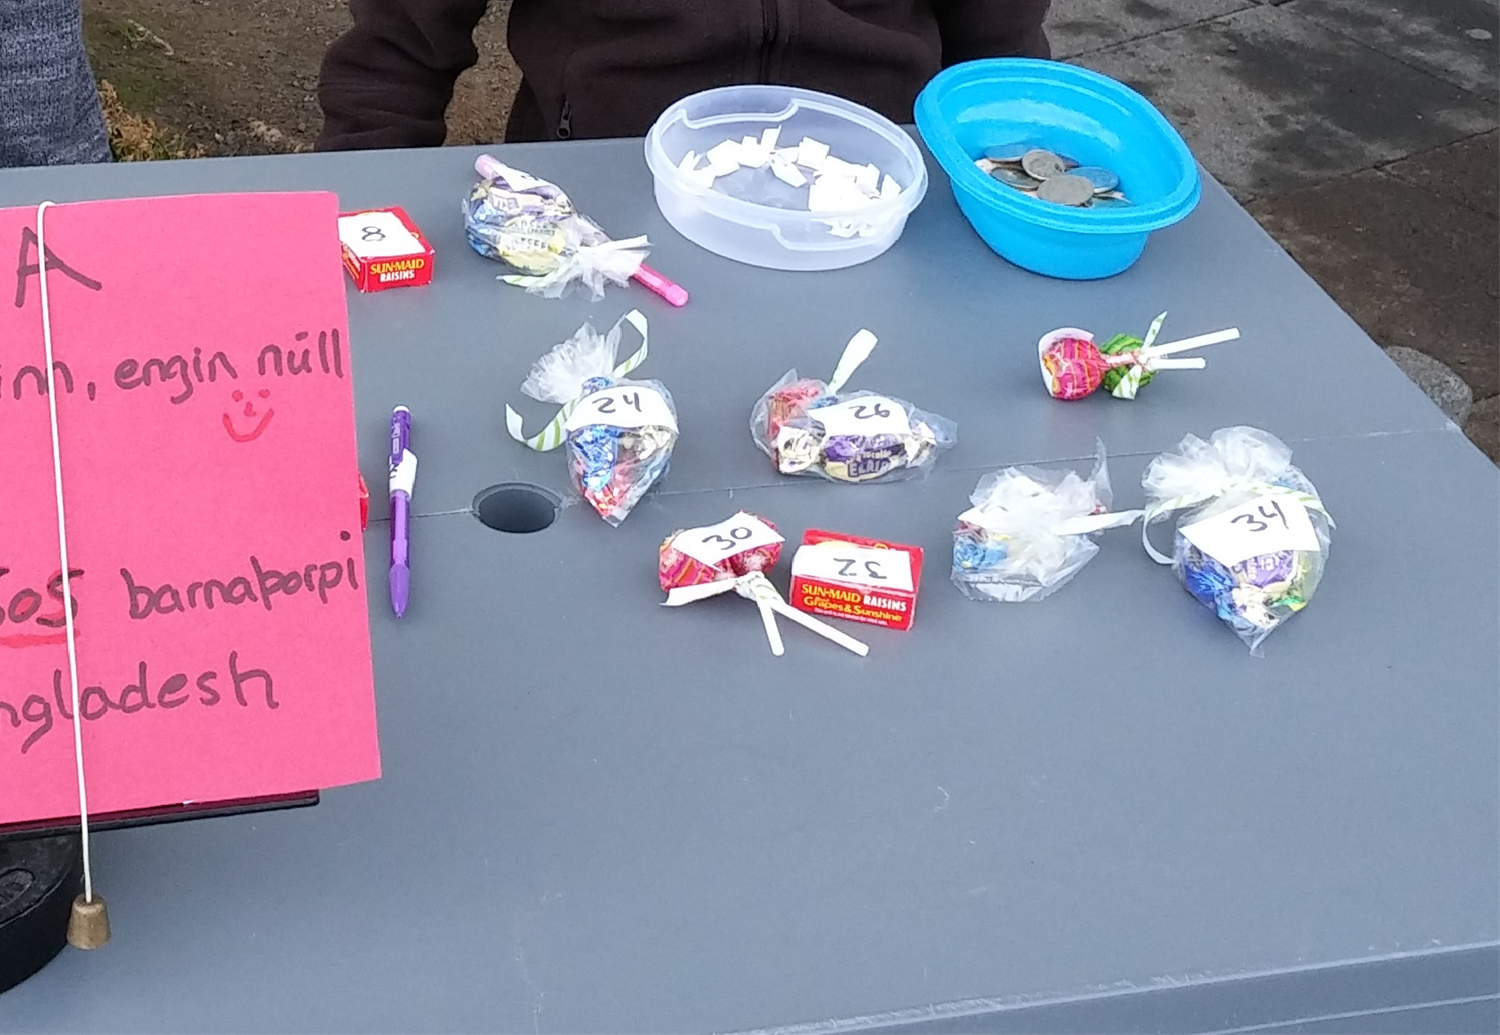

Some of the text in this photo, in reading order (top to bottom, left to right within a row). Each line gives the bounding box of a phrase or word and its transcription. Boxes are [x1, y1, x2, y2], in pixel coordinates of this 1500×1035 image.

[361, 226, 387, 242] 8
[370, 258, 425, 275] SUN-MAID
[379, 269, 416, 283] RAISINS
[114, 347, 238, 405] engin
[257, 328, 344, 379] núll
[591, 392, 642, 414] 24
[848, 403, 891, 420] 26
[1230, 500, 1289, 532] 34
[702, 527, 752, 550] 30
[801, 583, 907, 612] SUN-MAID RAISINS
[853, 605, 903, 623] Sunshine
